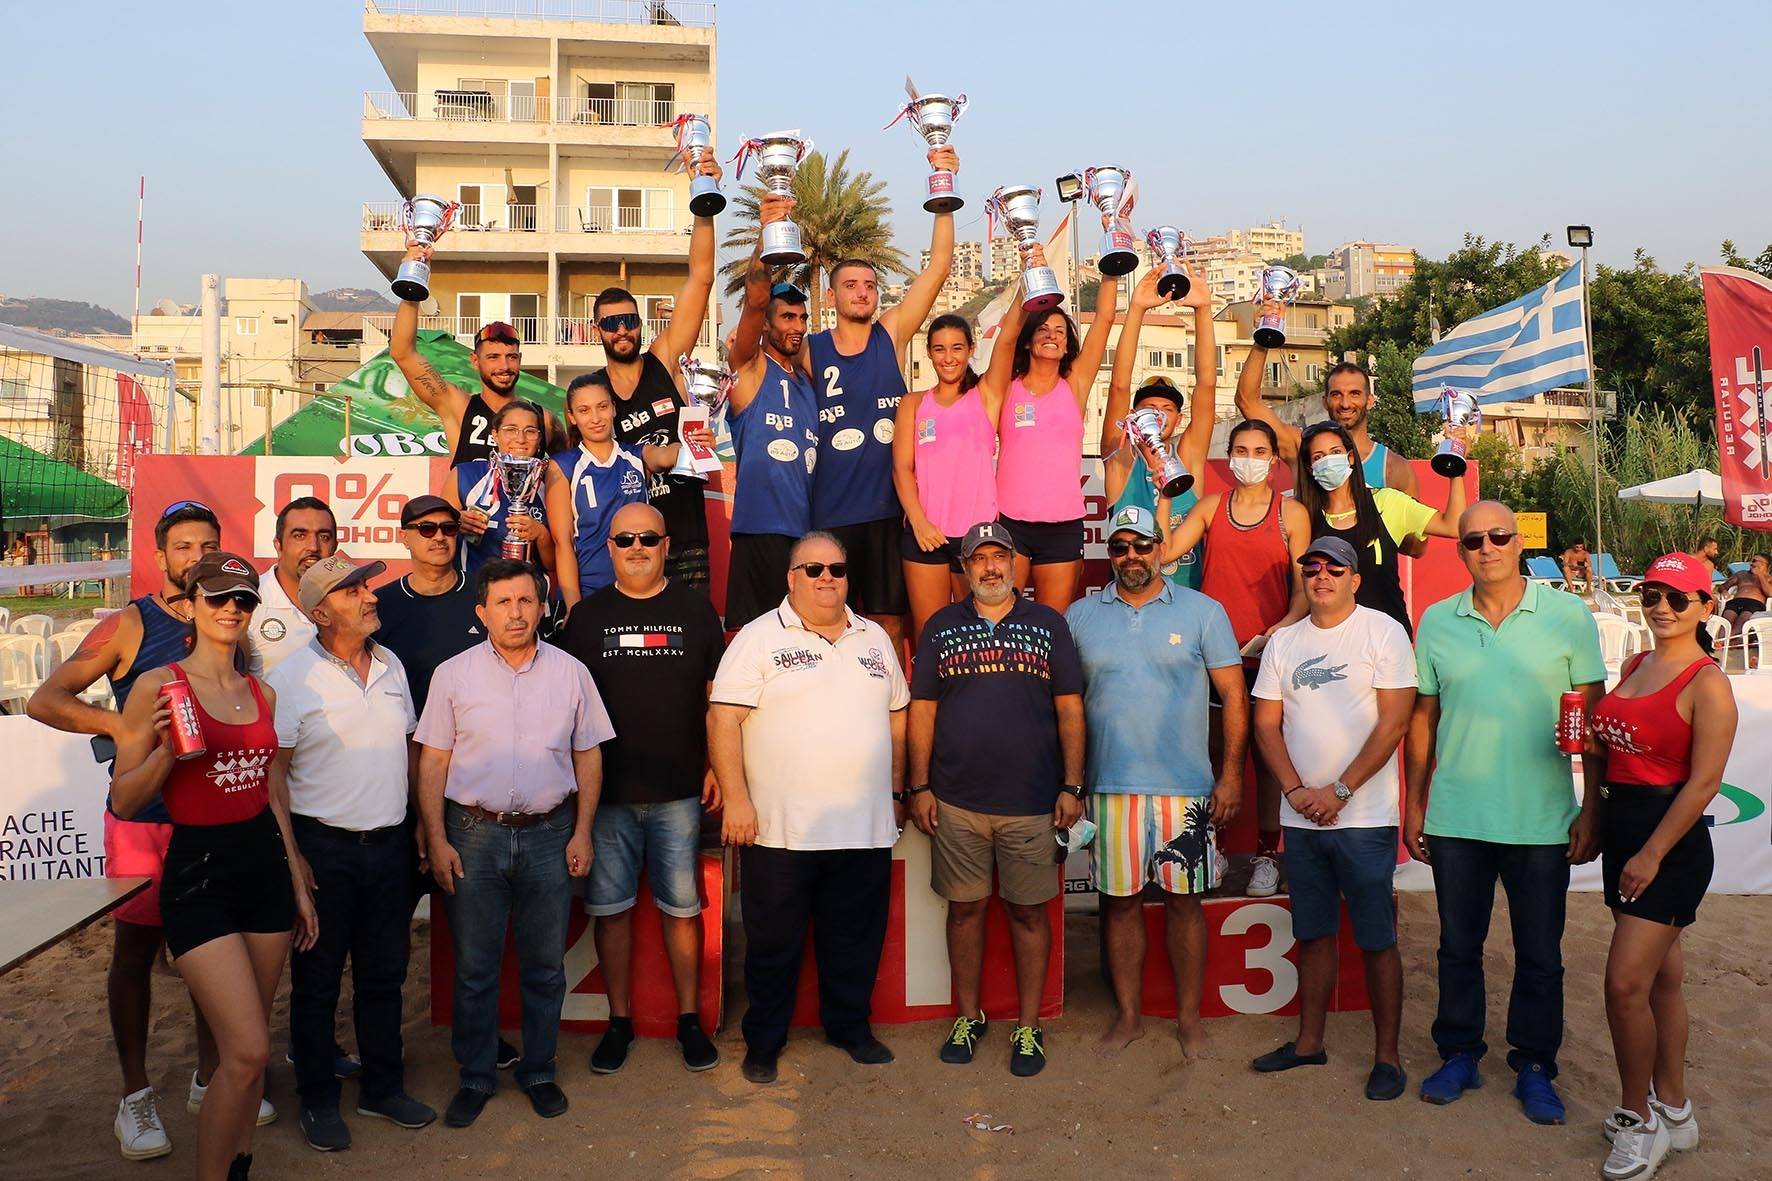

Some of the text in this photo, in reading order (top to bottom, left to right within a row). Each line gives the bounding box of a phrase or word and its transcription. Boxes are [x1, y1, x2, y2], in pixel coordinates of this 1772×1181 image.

[779, 379, 790, 409] 1
[823, 365, 844, 398] 2
[469, 415, 488, 446] 2
[274, 473, 409, 521] 0%
[580, 475, 598, 508] 1
[979, 525, 993, 537] H
[1366, 537, 1383, 565] 1
[603, 625, 683, 635] TOMMY HILFIGER
[603, 648, 684, 658] EST. MCMLXXXV
[216, 748, 274, 759] ENERGY
[224, 780, 260, 794] REGULAR
[2, 809, 76, 837] ACHE
[0, 833, 89, 862] RANCE
[1219, 903, 1299, 1015] 3
